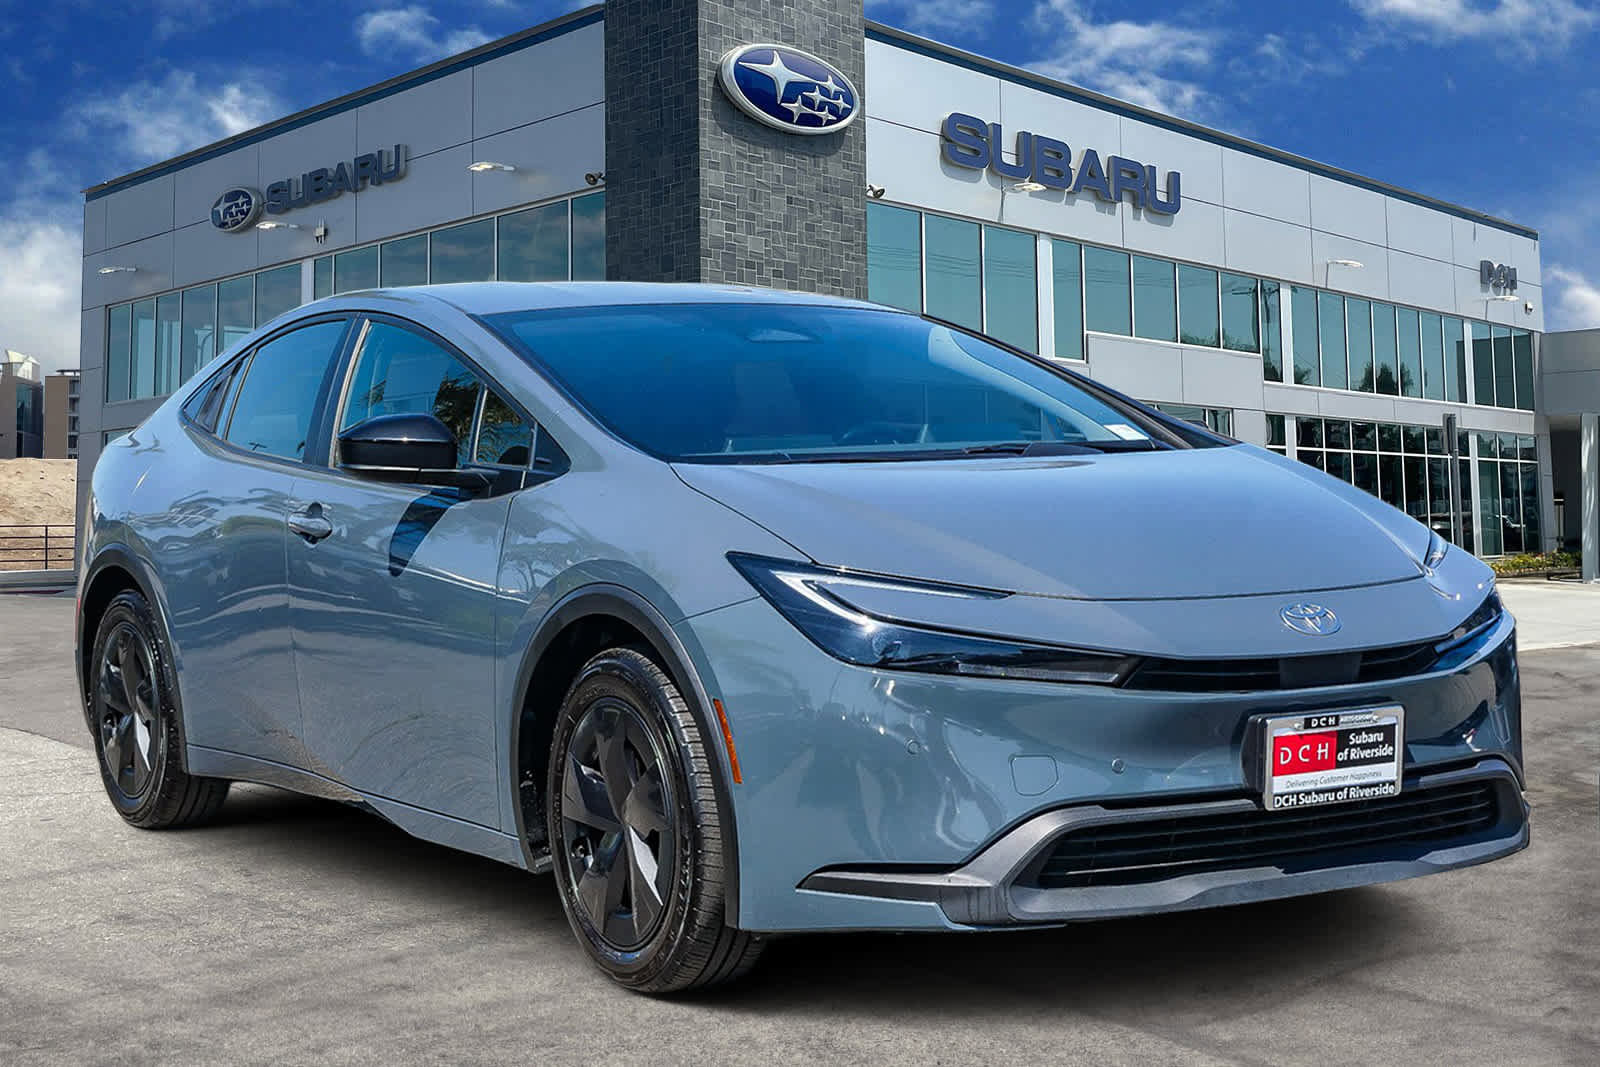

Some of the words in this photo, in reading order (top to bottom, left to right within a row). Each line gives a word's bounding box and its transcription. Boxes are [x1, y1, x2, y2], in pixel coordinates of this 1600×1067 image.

[942, 112, 1181, 216] SUBARU
[266, 144, 402, 215] SUBARU
[1311, 716, 1336, 728] DCH
[1349, 732, 1384, 745] Subaru
[1280, 742, 1329, 765] DCH
[1337, 750, 1349, 761] of
[1350, 744, 1393, 760] Riverside
[1320, 774, 1349, 784] Customer
[1274, 795, 1297, 808] DCH
[1298, 791, 1335, 805] Subaru
[1336, 789, 1348, 800] of
[1349, 784, 1395, 798] Riverside
